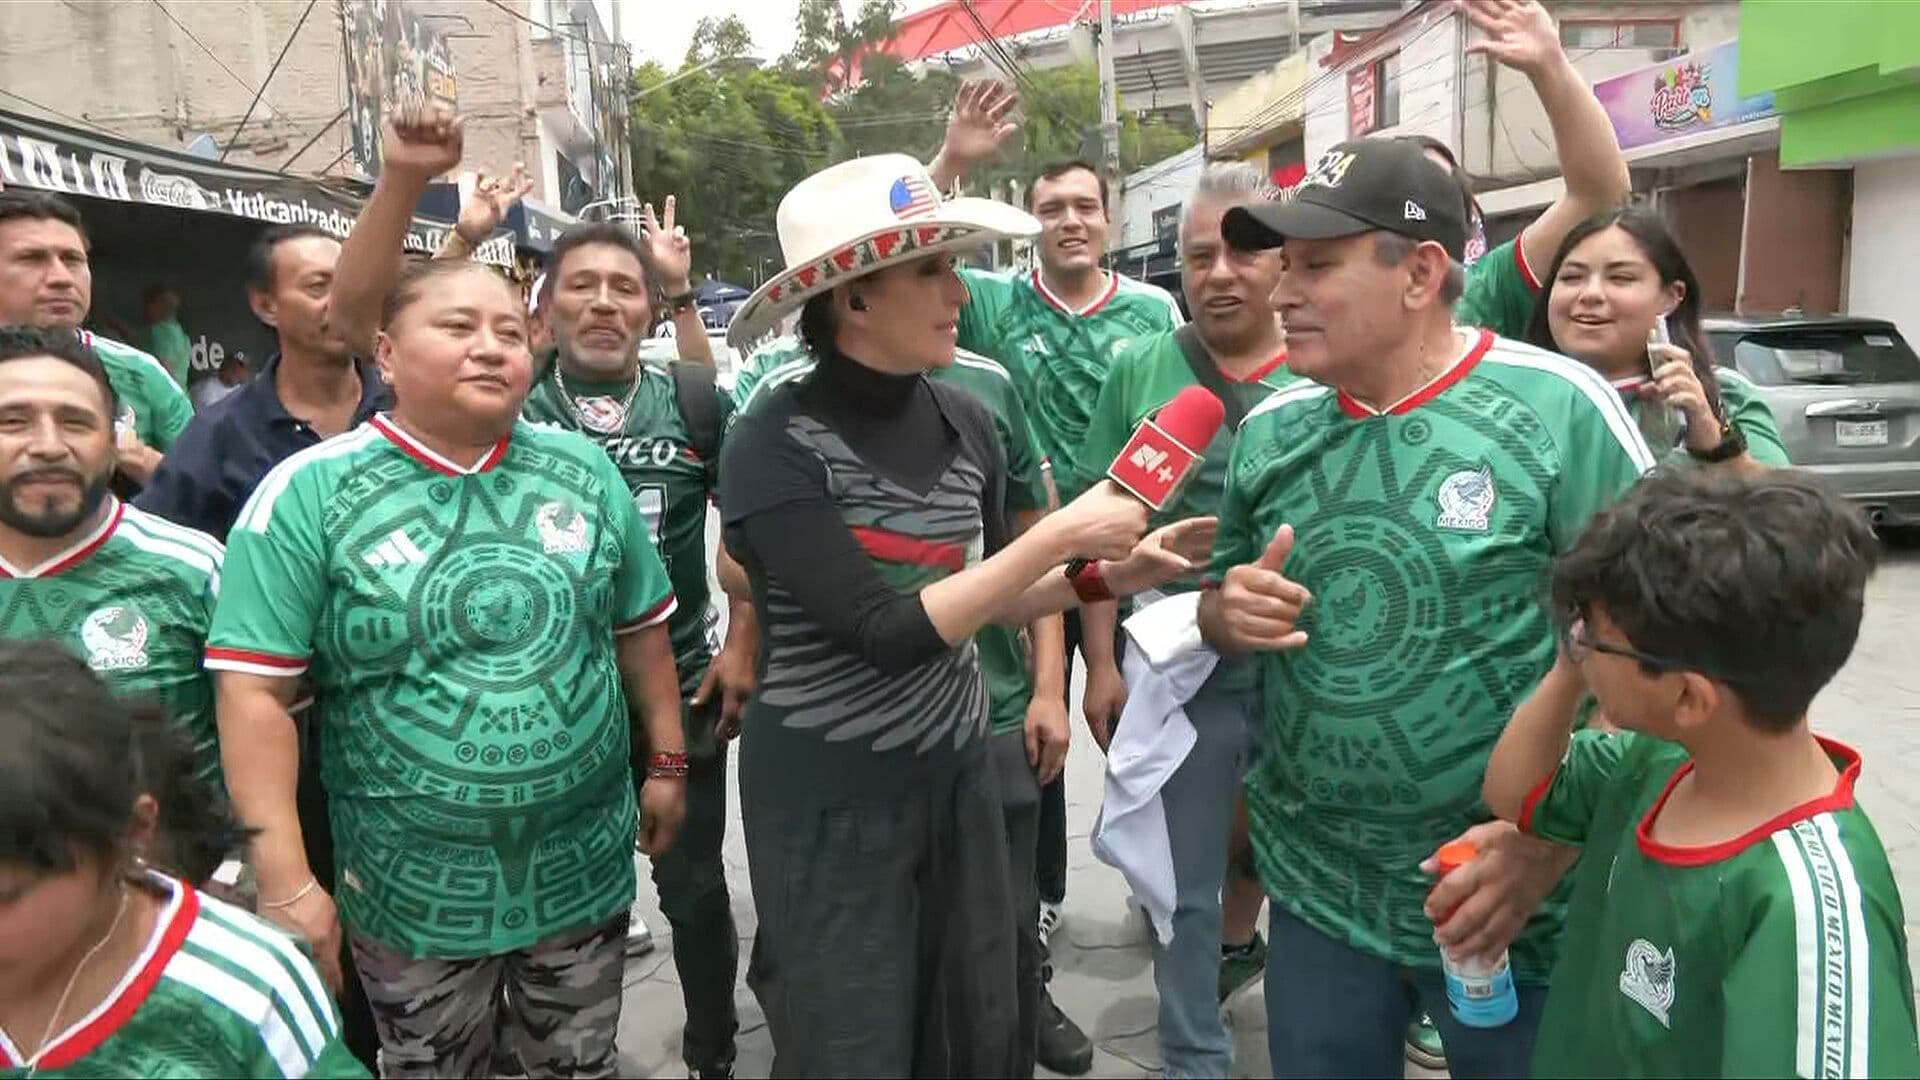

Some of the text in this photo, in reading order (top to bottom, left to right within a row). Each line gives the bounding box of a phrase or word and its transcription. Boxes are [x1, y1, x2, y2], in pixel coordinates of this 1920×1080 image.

[1438, 516, 1486, 528] MEXICO
[92, 655, 146, 668] EXICO
[1825, 915, 1843, 999] MEXICO
